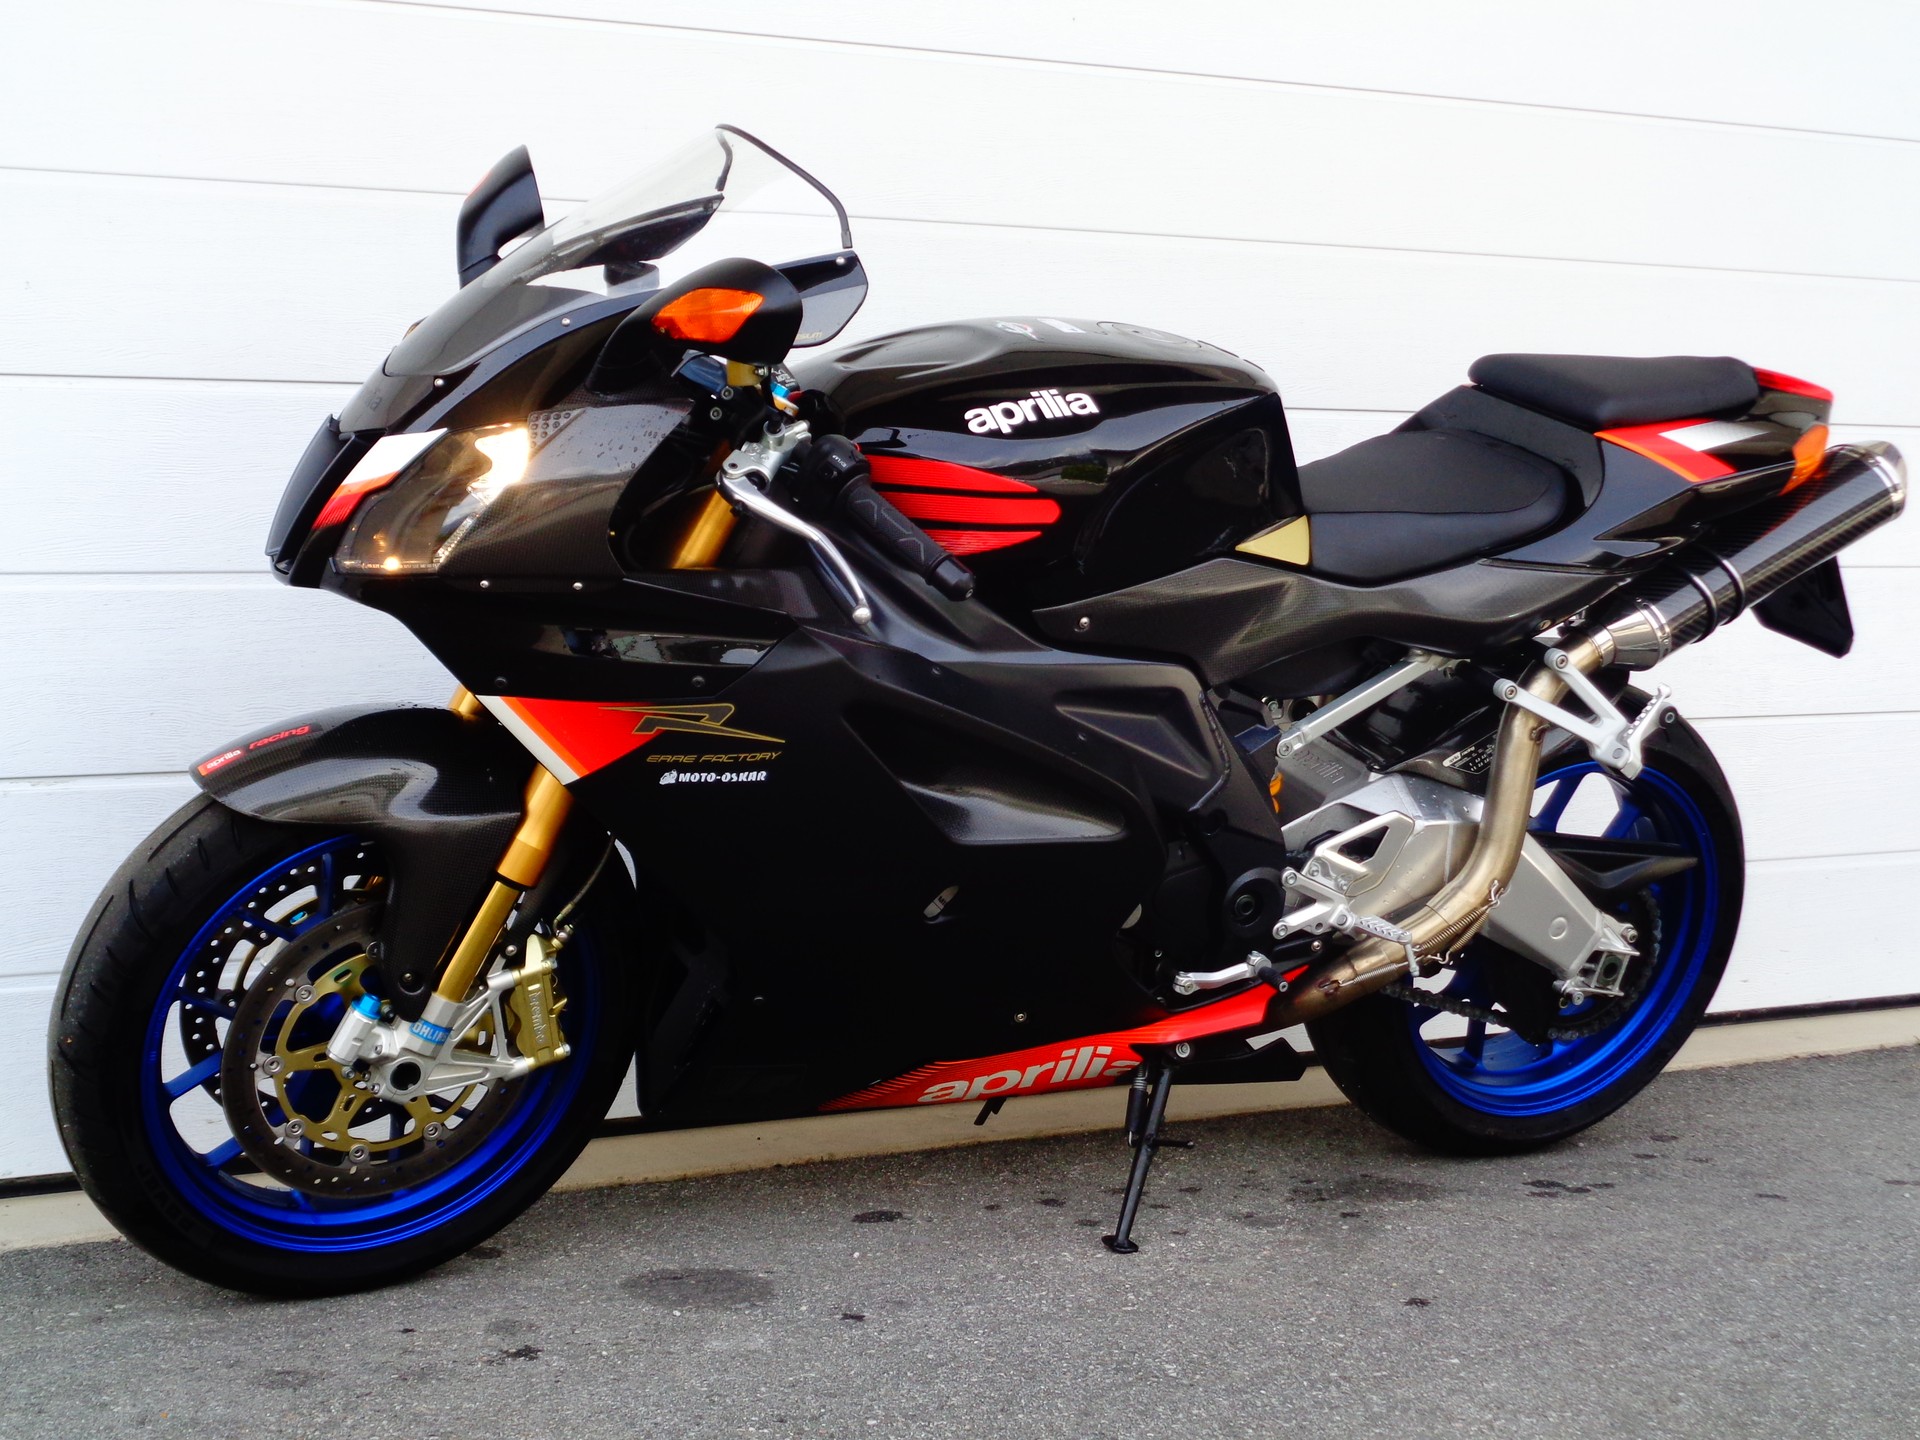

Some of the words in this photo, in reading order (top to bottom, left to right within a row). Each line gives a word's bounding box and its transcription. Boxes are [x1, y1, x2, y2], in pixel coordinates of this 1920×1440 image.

[964, 388, 1100, 435] aprilia
[206, 749, 242, 769] aprilia
[249, 725, 311, 750] racing
[699, 751, 782, 763] FACTORY
[678, 770, 767, 782] MOTO-OSKAR
